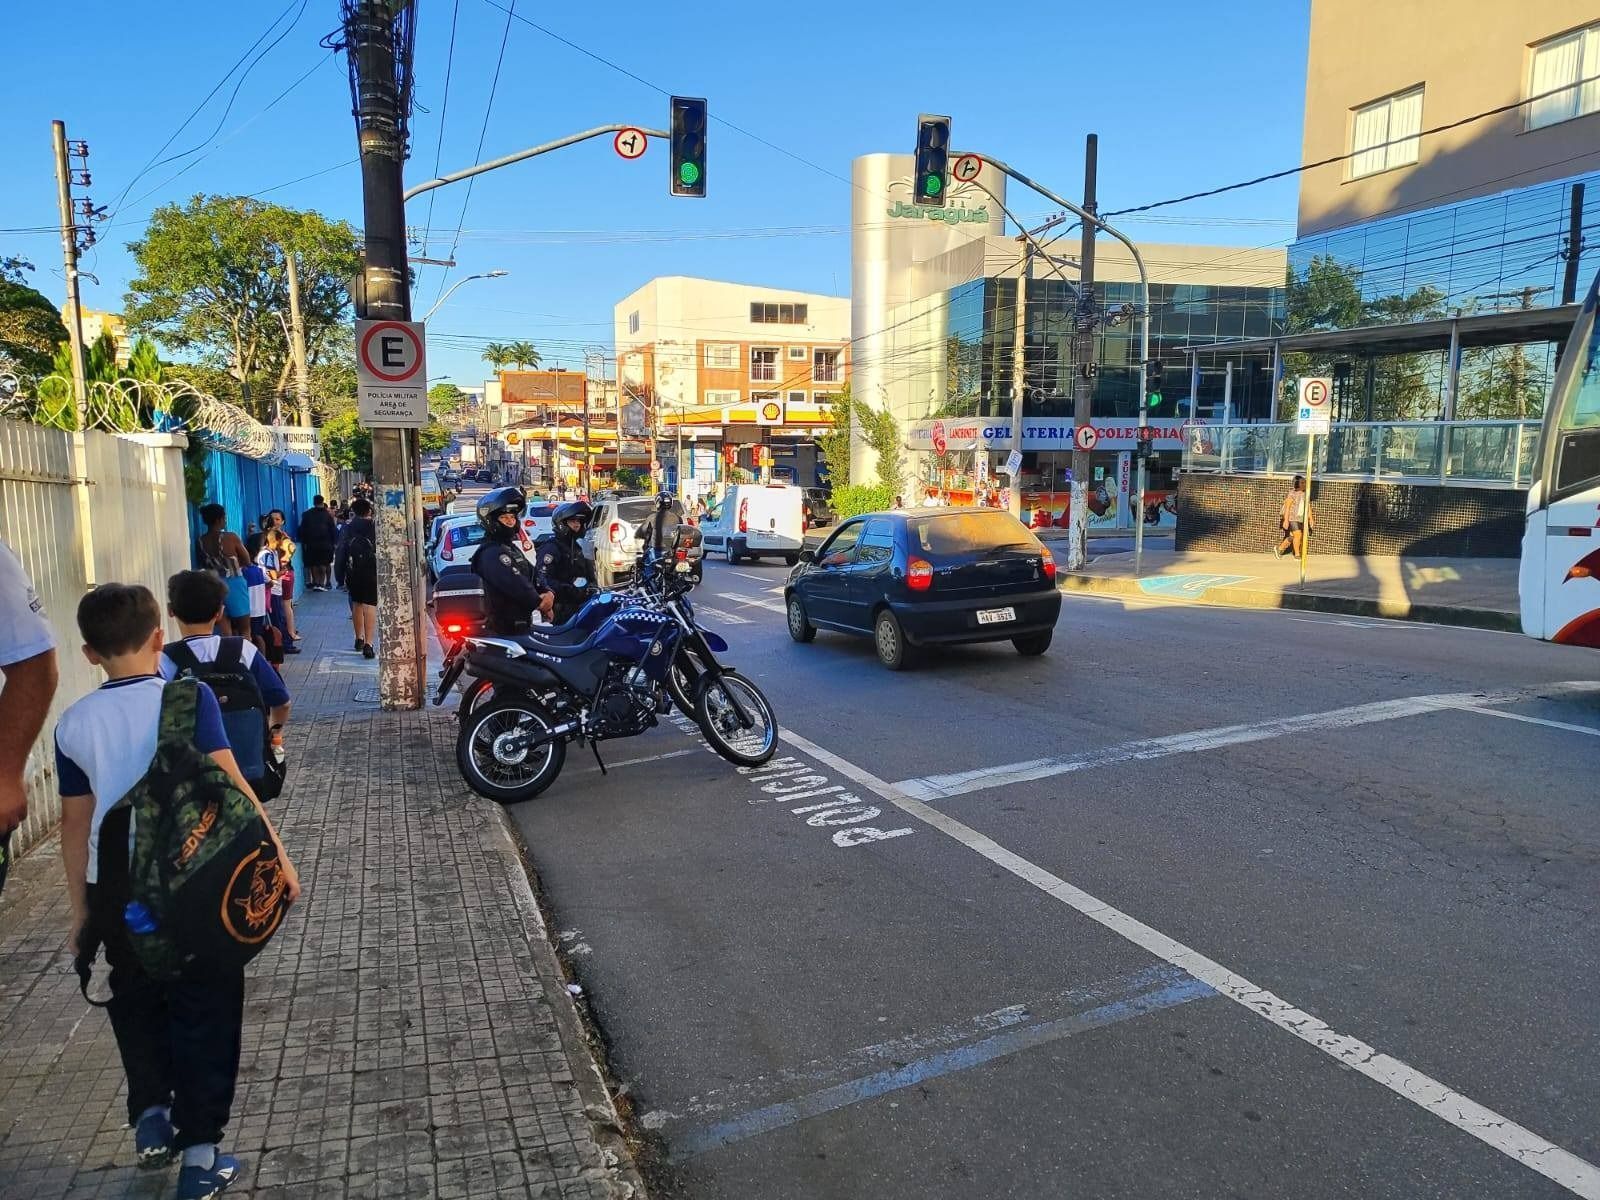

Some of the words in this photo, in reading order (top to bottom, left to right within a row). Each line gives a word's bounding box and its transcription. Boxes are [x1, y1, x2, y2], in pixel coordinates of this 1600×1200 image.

[886, 200, 990, 226] Jaraguá
[381, 336, 406, 367] E
[1311, 386, 1320, 401] E
[982, 427, 1074, 439] GELTERIA
